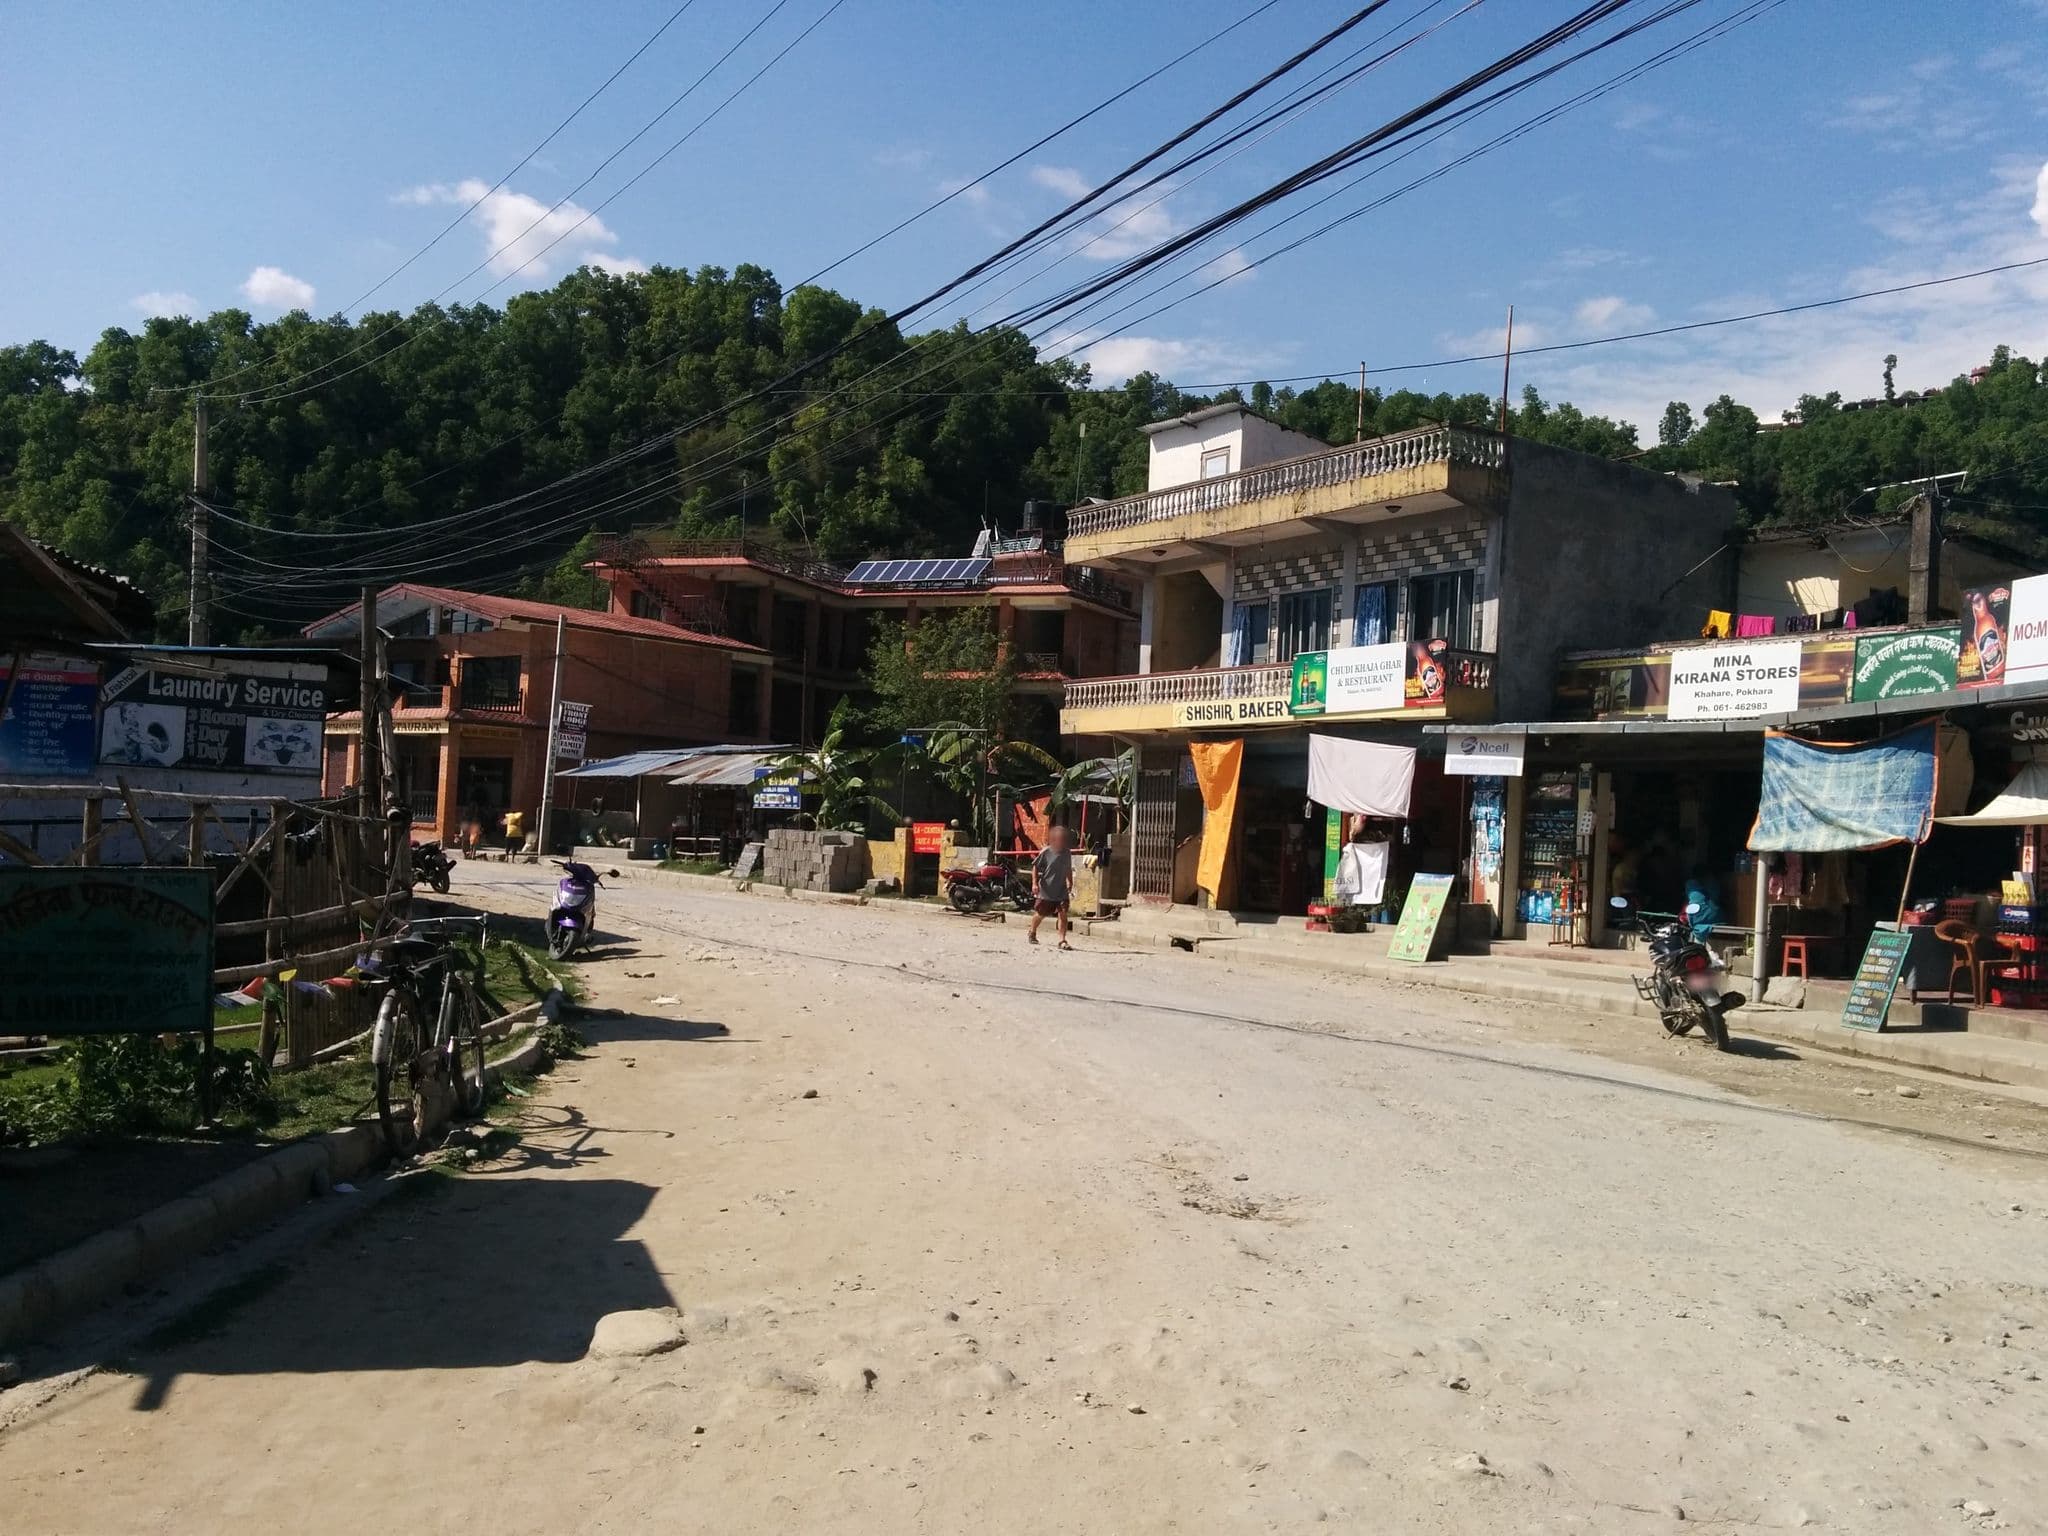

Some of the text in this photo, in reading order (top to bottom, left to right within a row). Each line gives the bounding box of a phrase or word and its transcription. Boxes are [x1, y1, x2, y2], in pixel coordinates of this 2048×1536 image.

[1330, 659, 1402, 675] CHUDI KHAJA GHAR
[1713, 654, 1752, 668] MINA
[1337, 673, 1393, 687] & RESTAURANT
[1674, 666, 1798, 685] KIRANA STORES
[148, 670, 324, 708] Laundry Service
[1694, 687, 1773, 698] Khahare, Pokhara
[1186, 700, 1291, 722] SHISHIR BAKERY
[1697, 704, 1711, 712] Ph.
[1735, 702, 1768, 711] 462983
[270, 710, 286, 719] Dry
[562, 716, 587, 726] LODGE
[198, 723, 229, 744] Day
[559, 734, 585, 743] JASMINE
[560, 740, 582, 749] FAMILY
[1479, 742, 1509, 753] Ncell
[197, 742, 228, 766] Day
[561, 747, 579, 756] HOME
